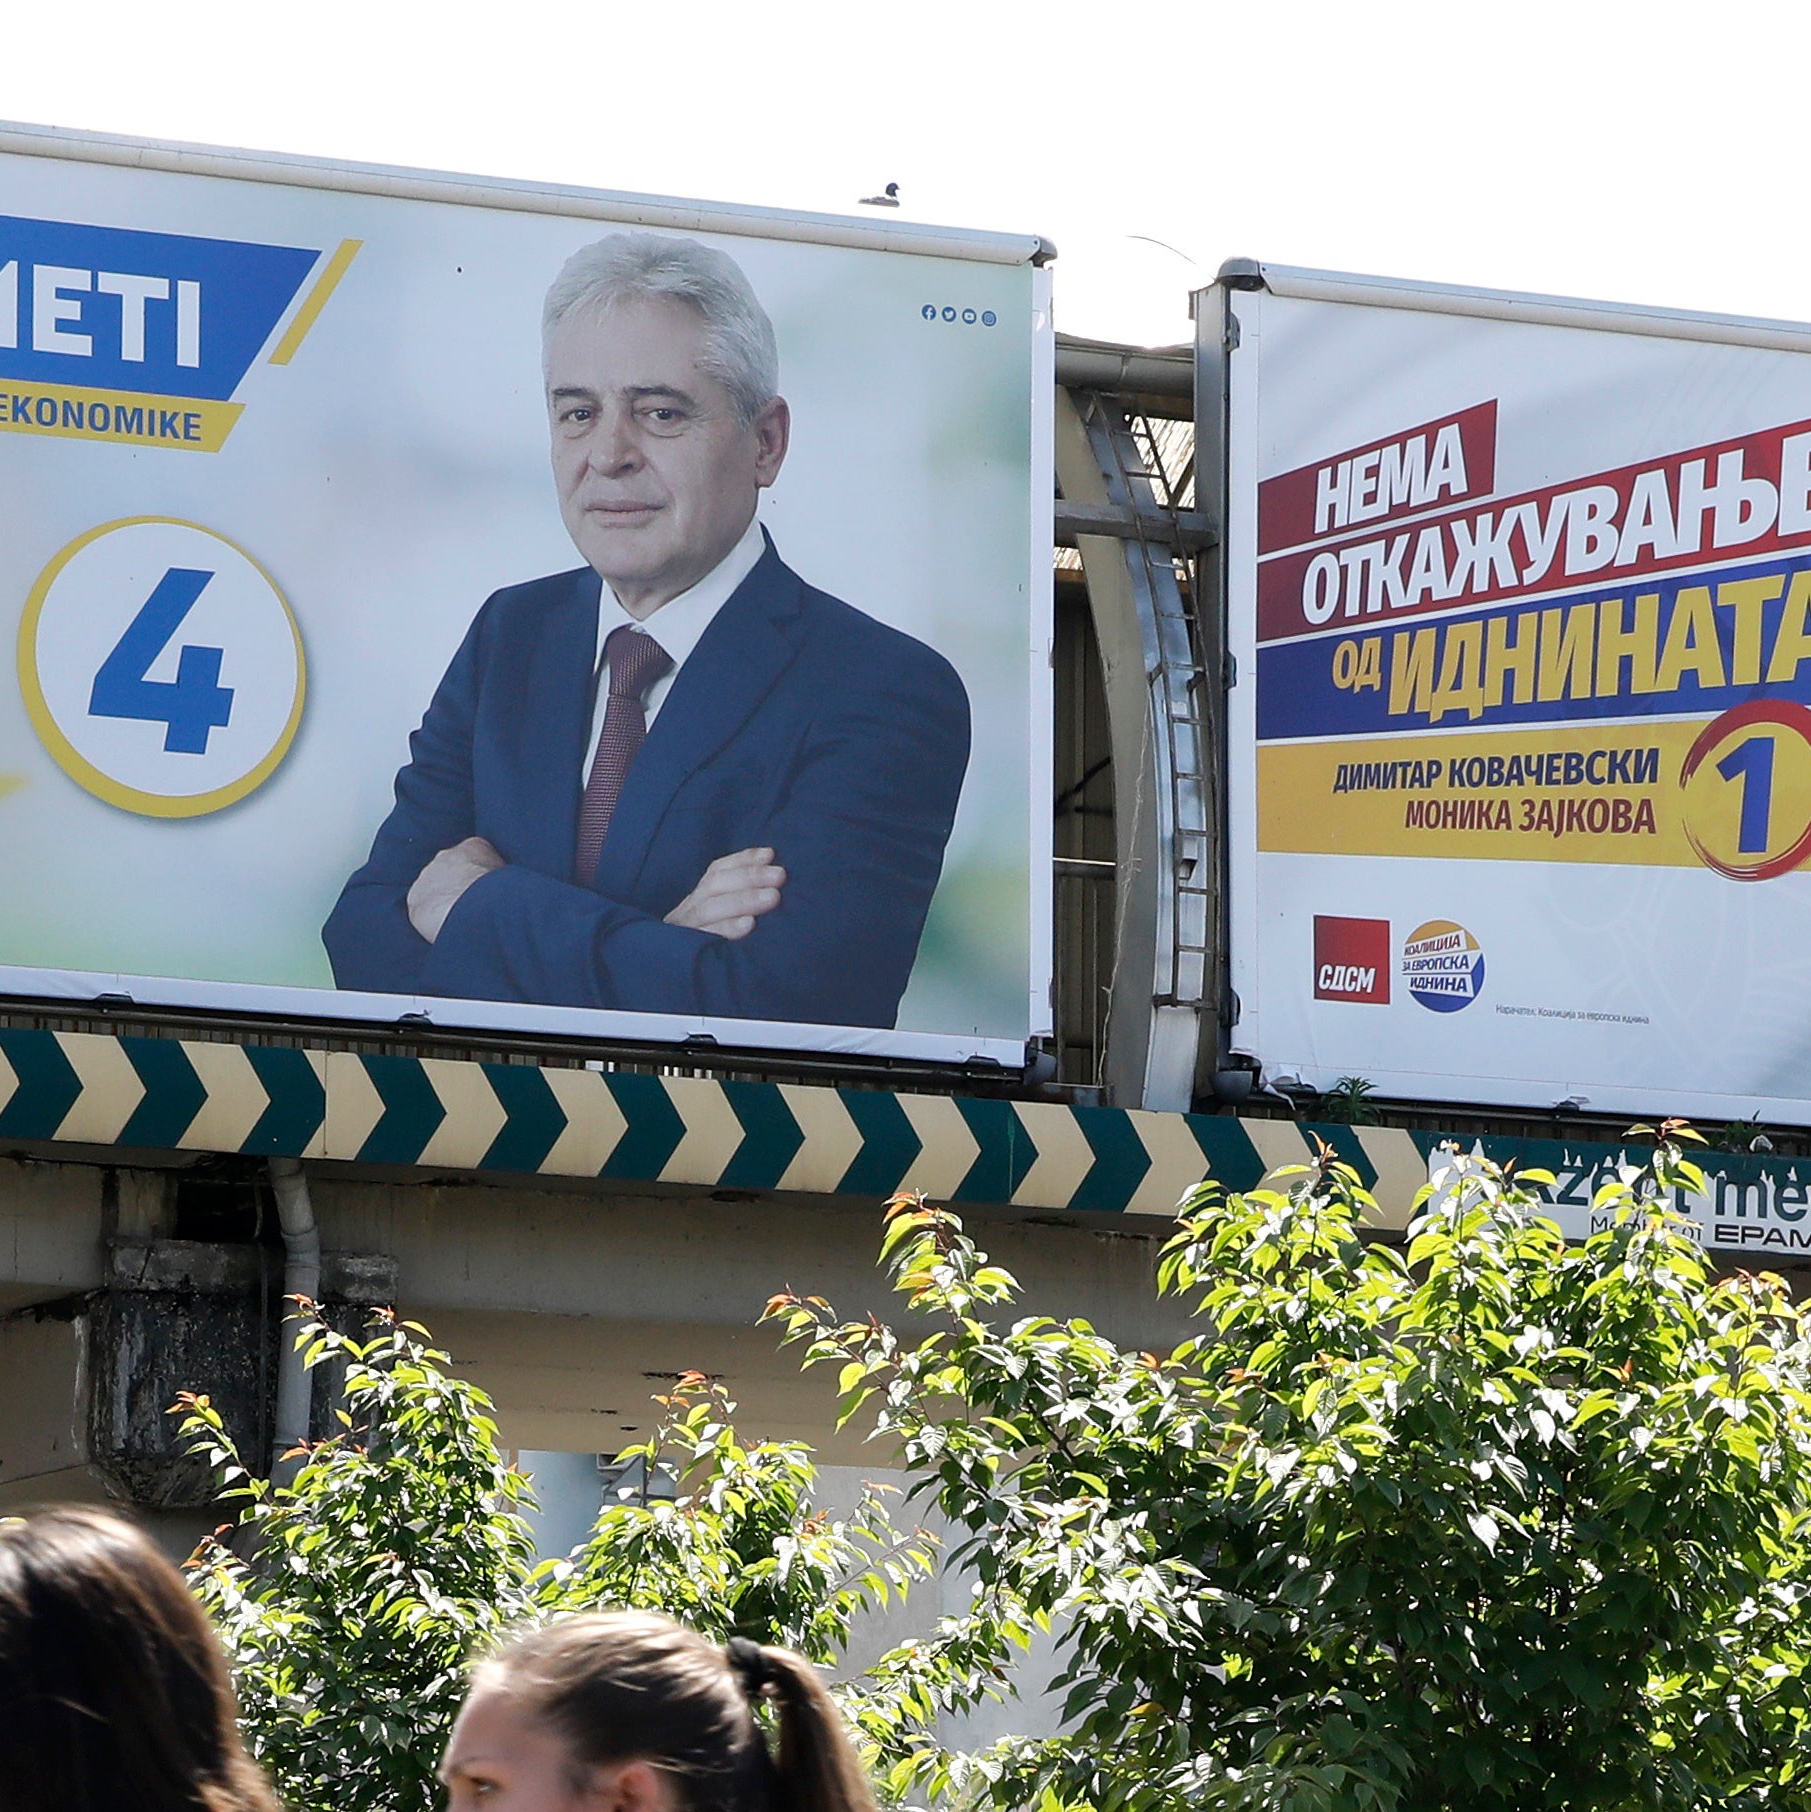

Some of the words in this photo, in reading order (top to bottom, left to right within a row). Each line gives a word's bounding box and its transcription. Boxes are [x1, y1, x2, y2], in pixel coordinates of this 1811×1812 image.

[1313, 422, 1468, 535] НЕМА
[86, 566, 235, 755] 4
[1333, 759, 1443, 794] ДИМИТАР
[1447, 746, 1659, 789] КОВАЧЕВСКИ
[1714, 736, 1775, 853] 1
[1404, 798, 1513, 831] МОНИКА
[1518, 798, 1657, 839] ЗАЈКОВА
[1404, 933, 1461, 957] КОАЛИЦИЈА
[1411, 954, 1470, 971] ЕВРОПСКА
[1318, 963, 1376, 994] СДСМ
[1410, 976, 1468, 993] ИДНИНА
